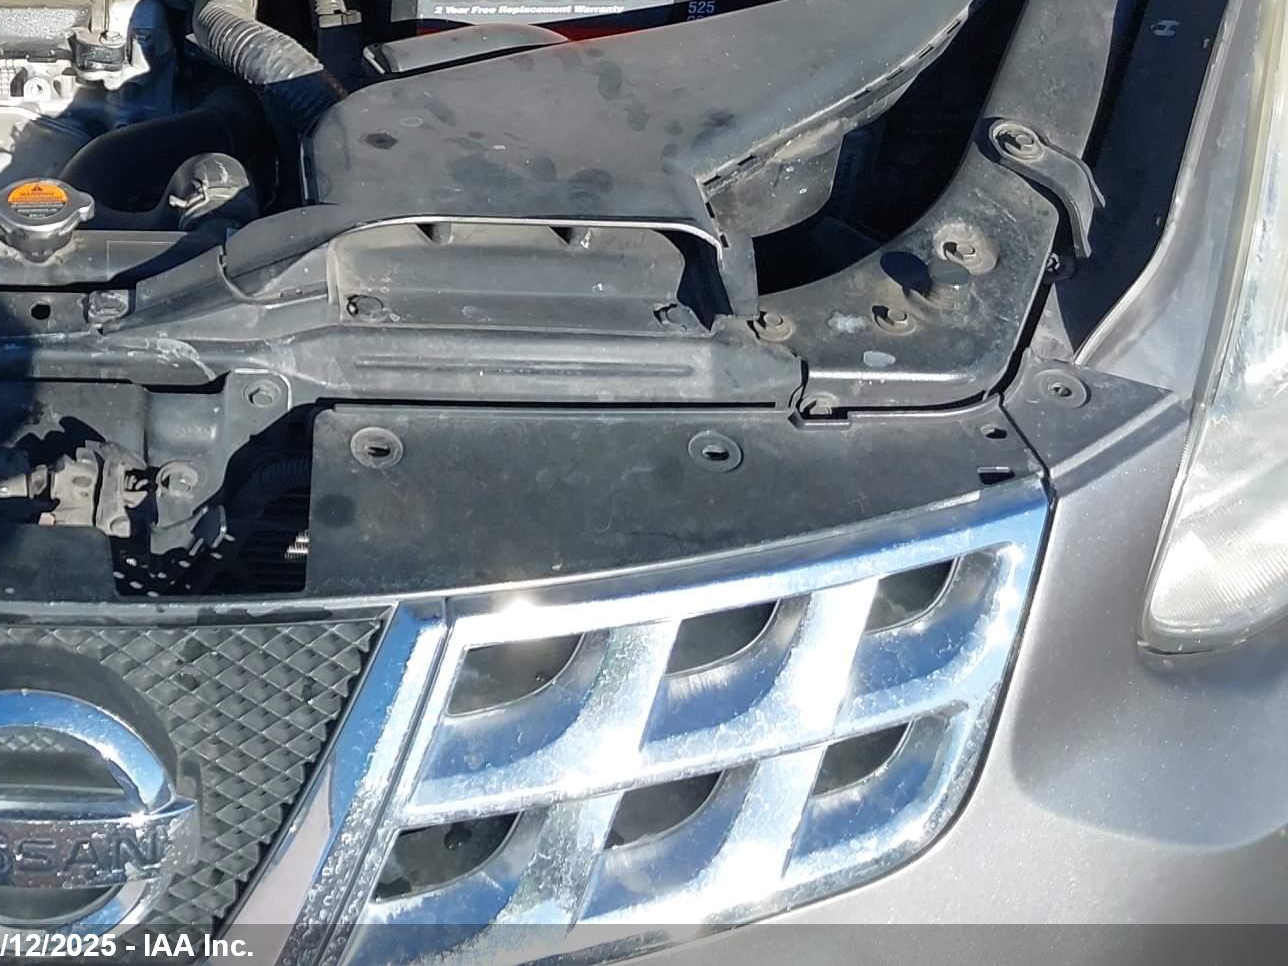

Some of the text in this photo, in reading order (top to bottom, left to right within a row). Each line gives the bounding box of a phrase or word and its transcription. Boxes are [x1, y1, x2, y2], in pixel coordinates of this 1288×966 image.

[434, 4, 625, 15] 2 Year Free Replacement Warranty
[688, 1, 716, 14] 525
